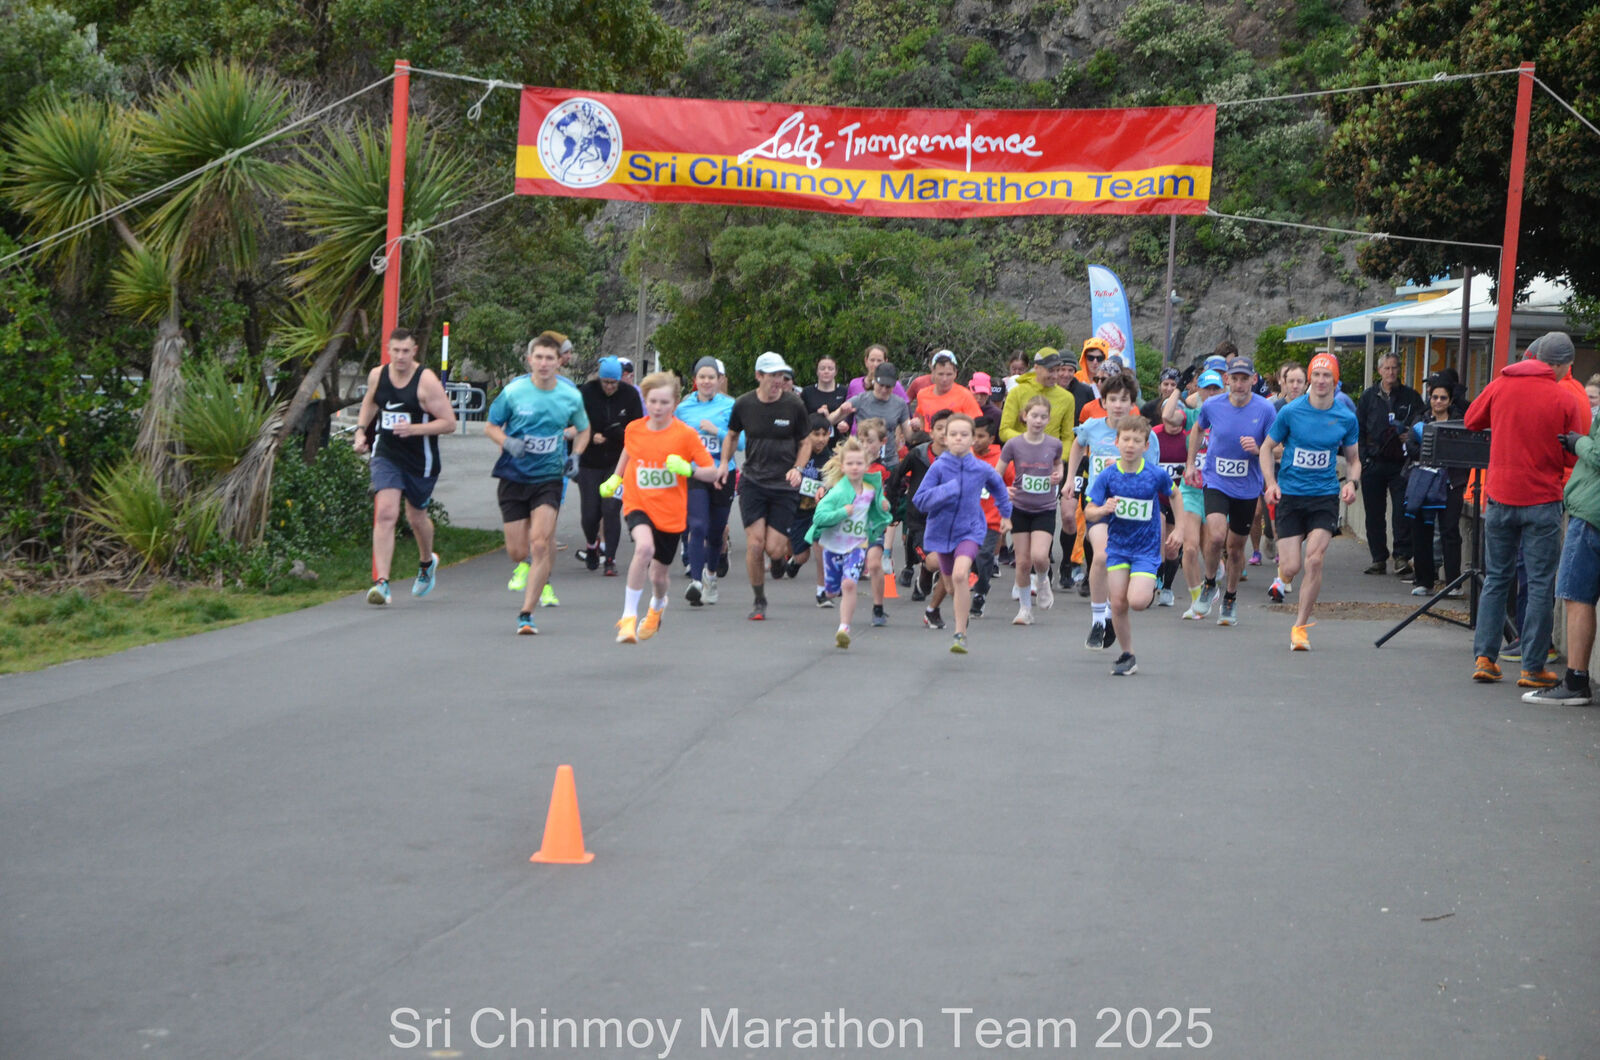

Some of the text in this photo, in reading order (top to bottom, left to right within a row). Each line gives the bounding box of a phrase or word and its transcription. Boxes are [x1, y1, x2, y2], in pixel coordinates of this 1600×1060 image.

[737, 111, 1043, 172] Self-Transcendence
[628, 153, 1195, 203] Sri Chinmoy Marathon Team
[528, 438, 555, 452] 537
[1218, 460, 1245, 474] 526
[1296, 451, 1327, 467] 538
[639, 469, 673, 487] 360
[1024, 476, 1050, 492] 366
[1115, 500, 1148, 518] 361
[842, 519, 866, 535] 36
